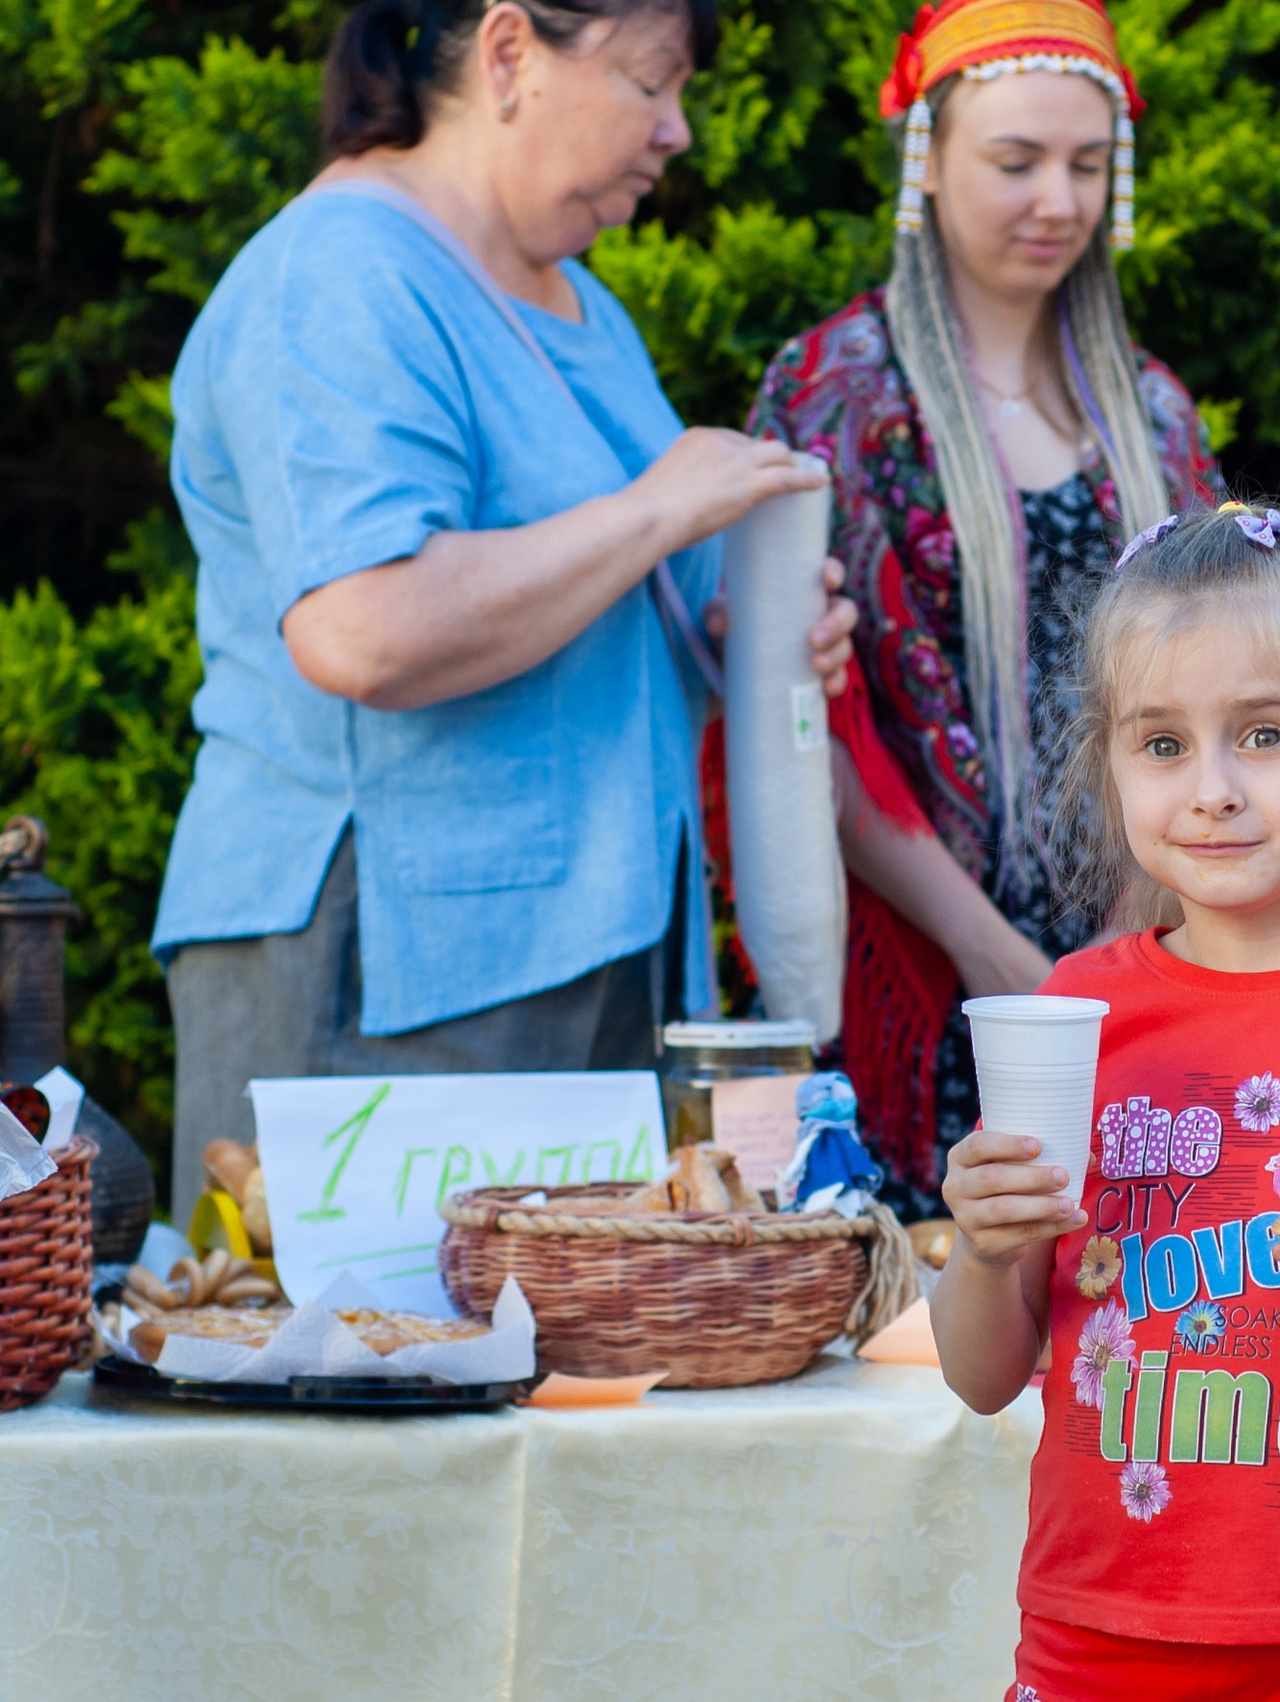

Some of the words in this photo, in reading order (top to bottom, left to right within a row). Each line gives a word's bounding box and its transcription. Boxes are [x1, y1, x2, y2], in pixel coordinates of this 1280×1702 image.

[297, 1081, 393, 1222] 1
[1097, 1096, 1223, 1181] the
[1095, 1183, 1196, 1235] CITY
[1170, 1332, 1273, 1360] ENDLESS
